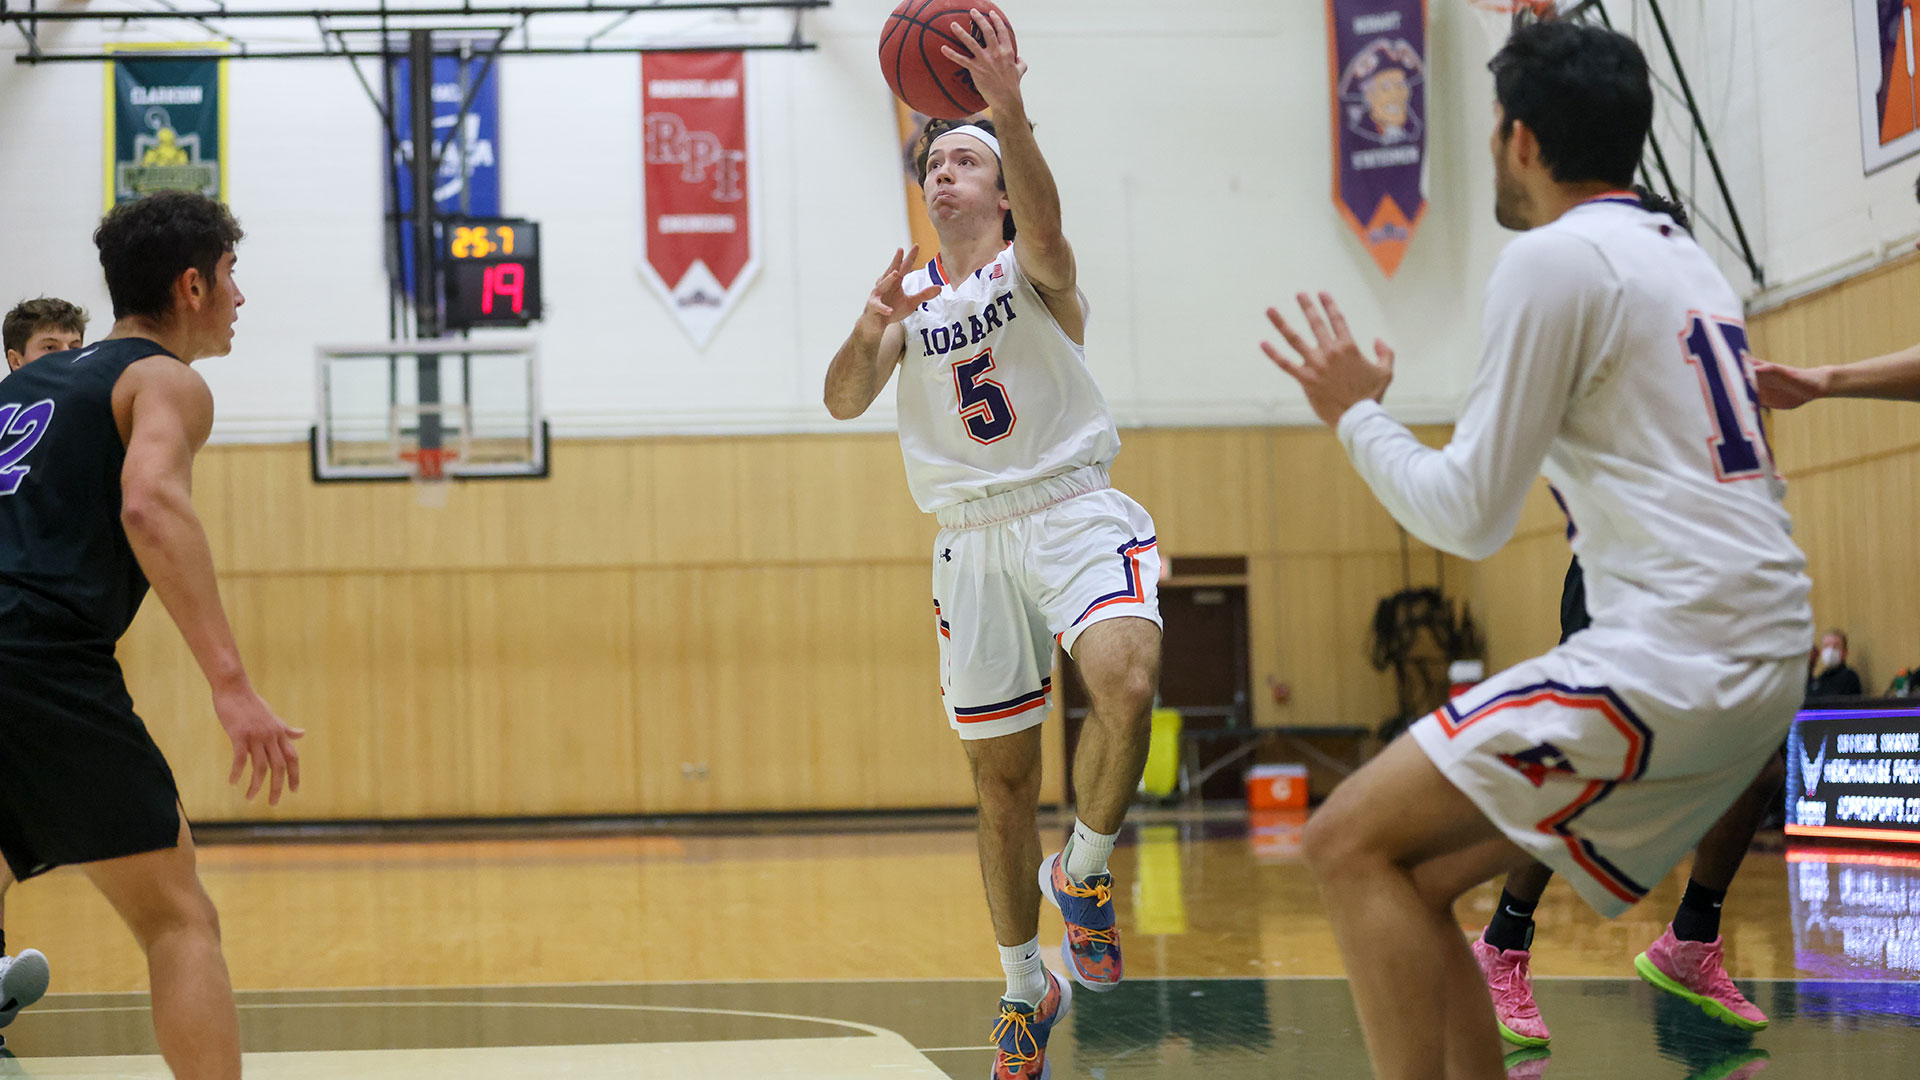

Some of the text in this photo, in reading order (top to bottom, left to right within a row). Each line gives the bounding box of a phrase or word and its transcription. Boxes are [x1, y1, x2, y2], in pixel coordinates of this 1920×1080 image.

[644, 112, 745, 202] RPI
[451, 225, 515, 258] 25.7
[481, 262, 525, 314] 19
[952, 347, 1017, 445] 5
